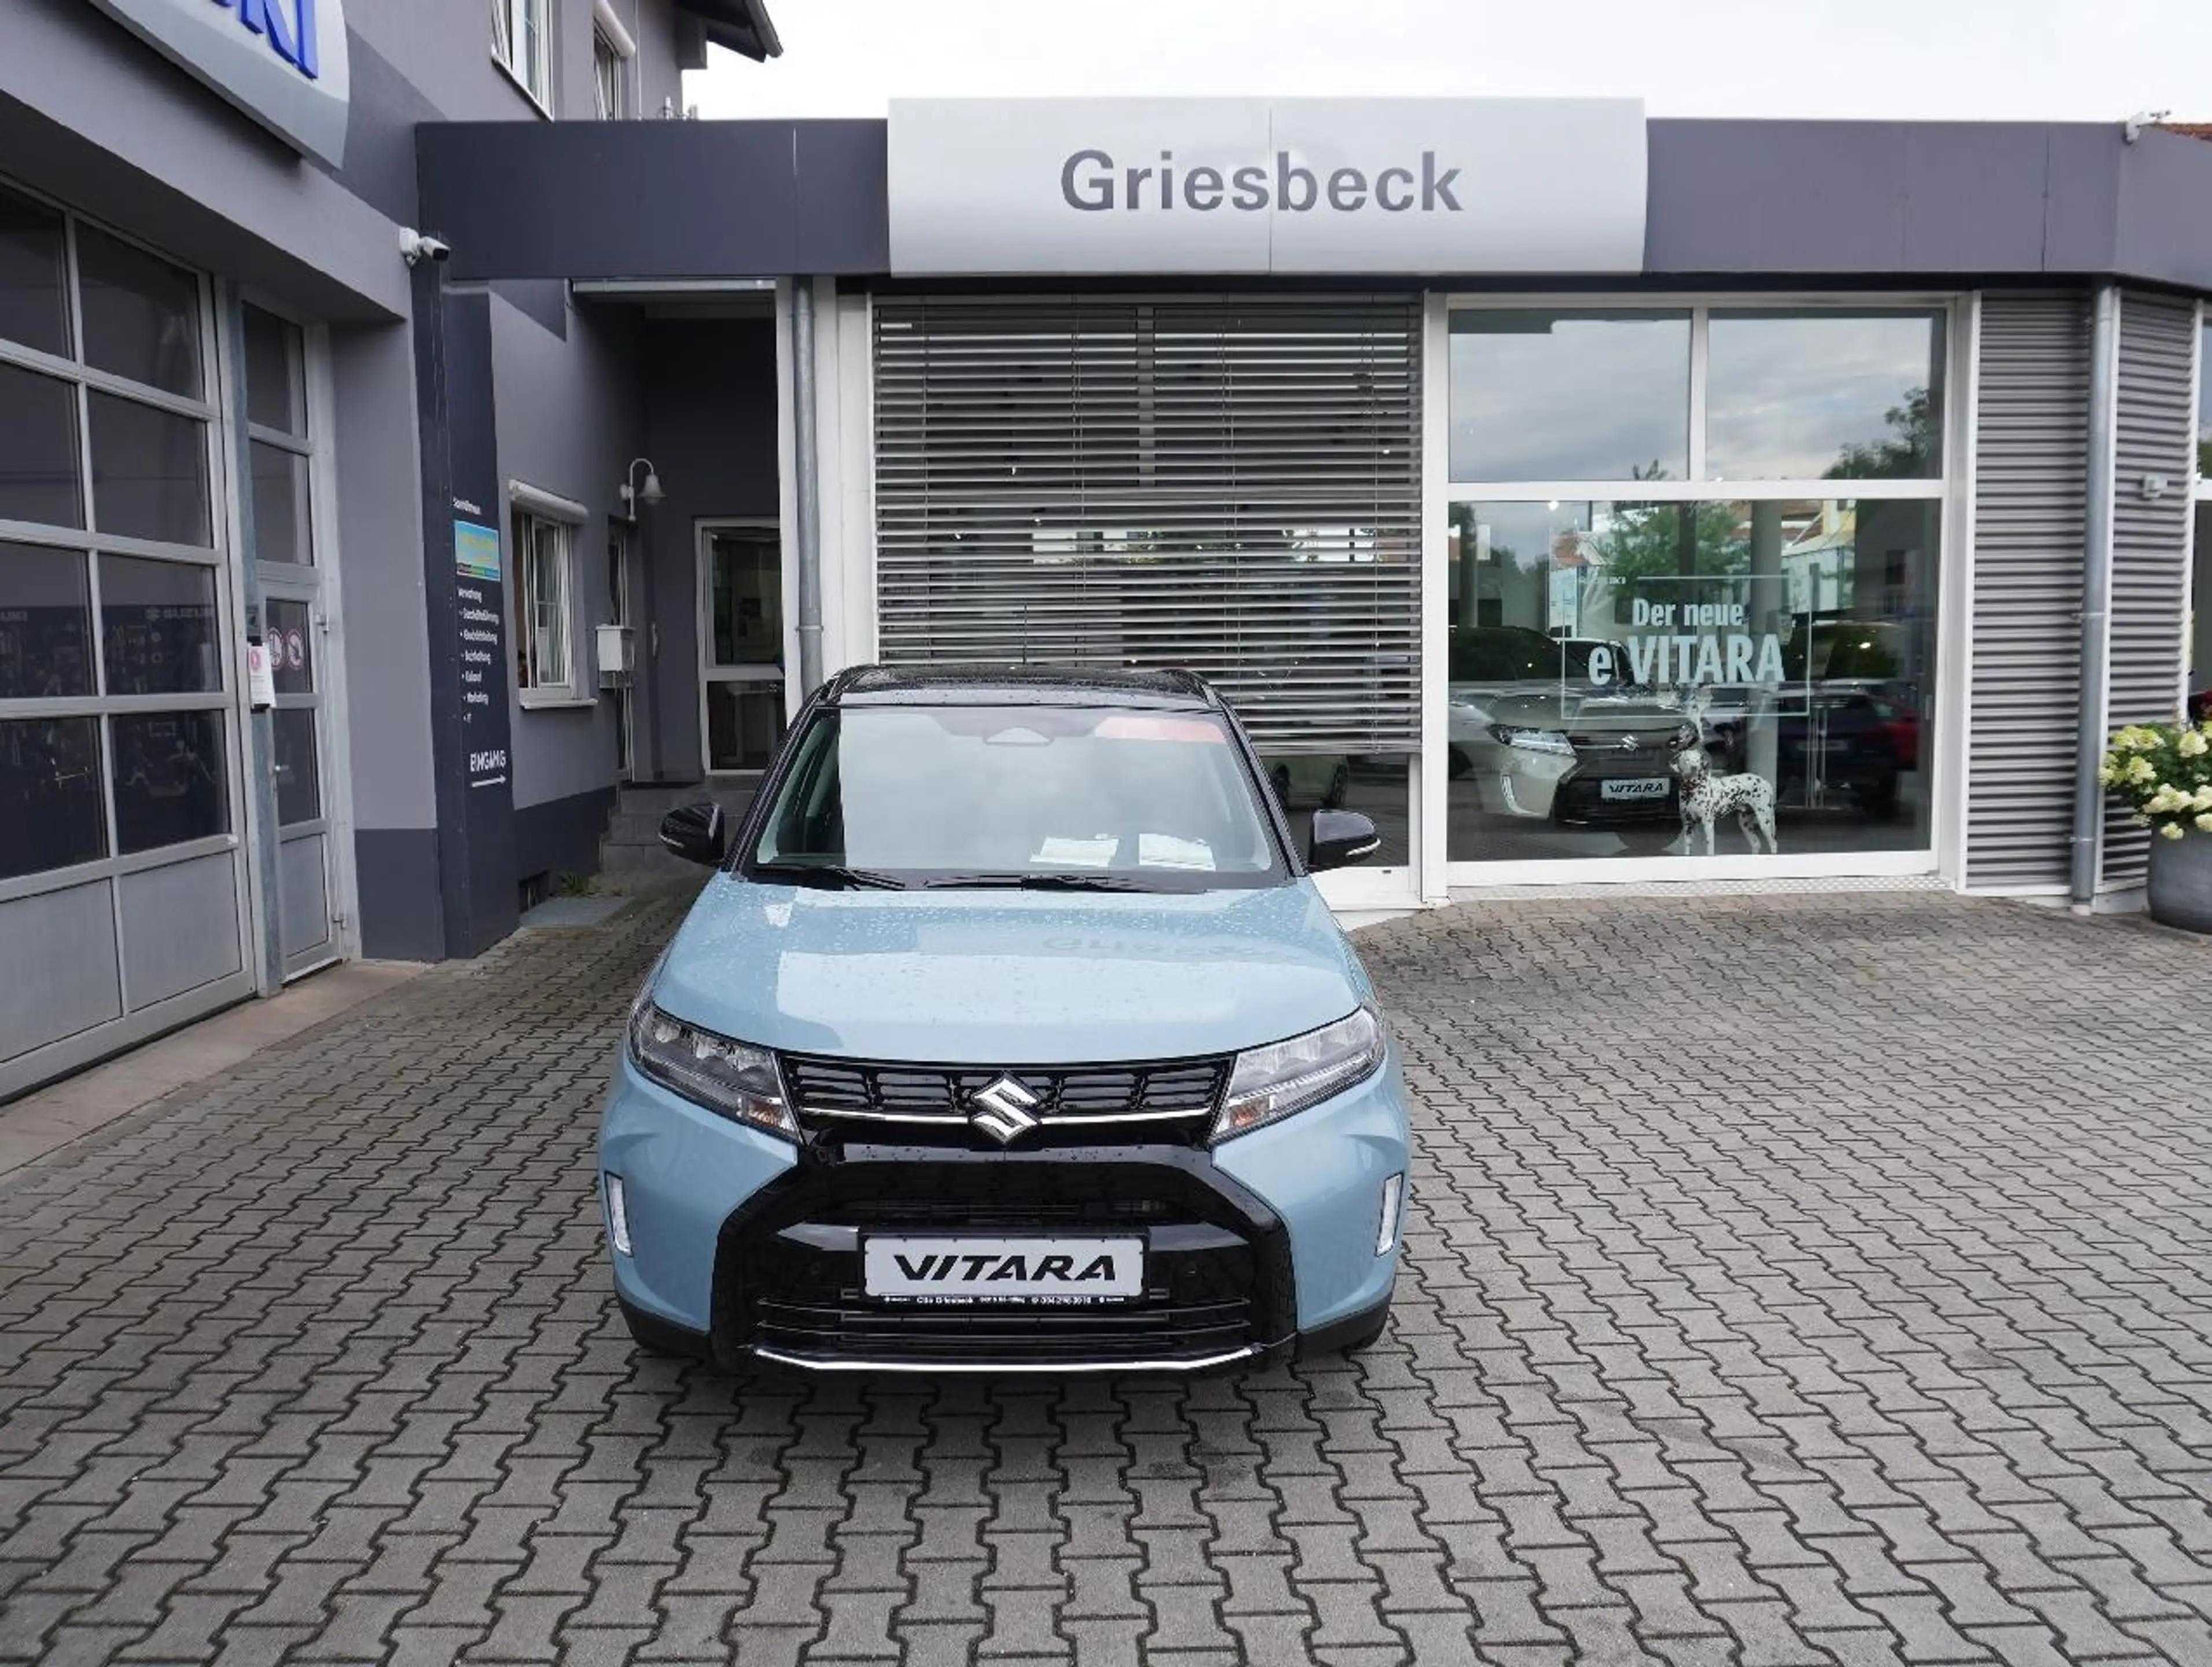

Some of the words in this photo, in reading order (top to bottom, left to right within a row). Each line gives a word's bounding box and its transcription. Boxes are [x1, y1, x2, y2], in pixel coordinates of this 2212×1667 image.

[1061, 149, 1465, 212] Griesbeck
[1632, 597, 1676, 627] Der
[1684, 603, 1744, 627] neue
[1589, 646, 1612, 685] e
[1627, 634, 1786, 685] VITARA
[470, 750, 506, 772] EINGANG
[1609, 783, 1663, 793] VITARA
[894, 1255, 1116, 1281] VITARA
